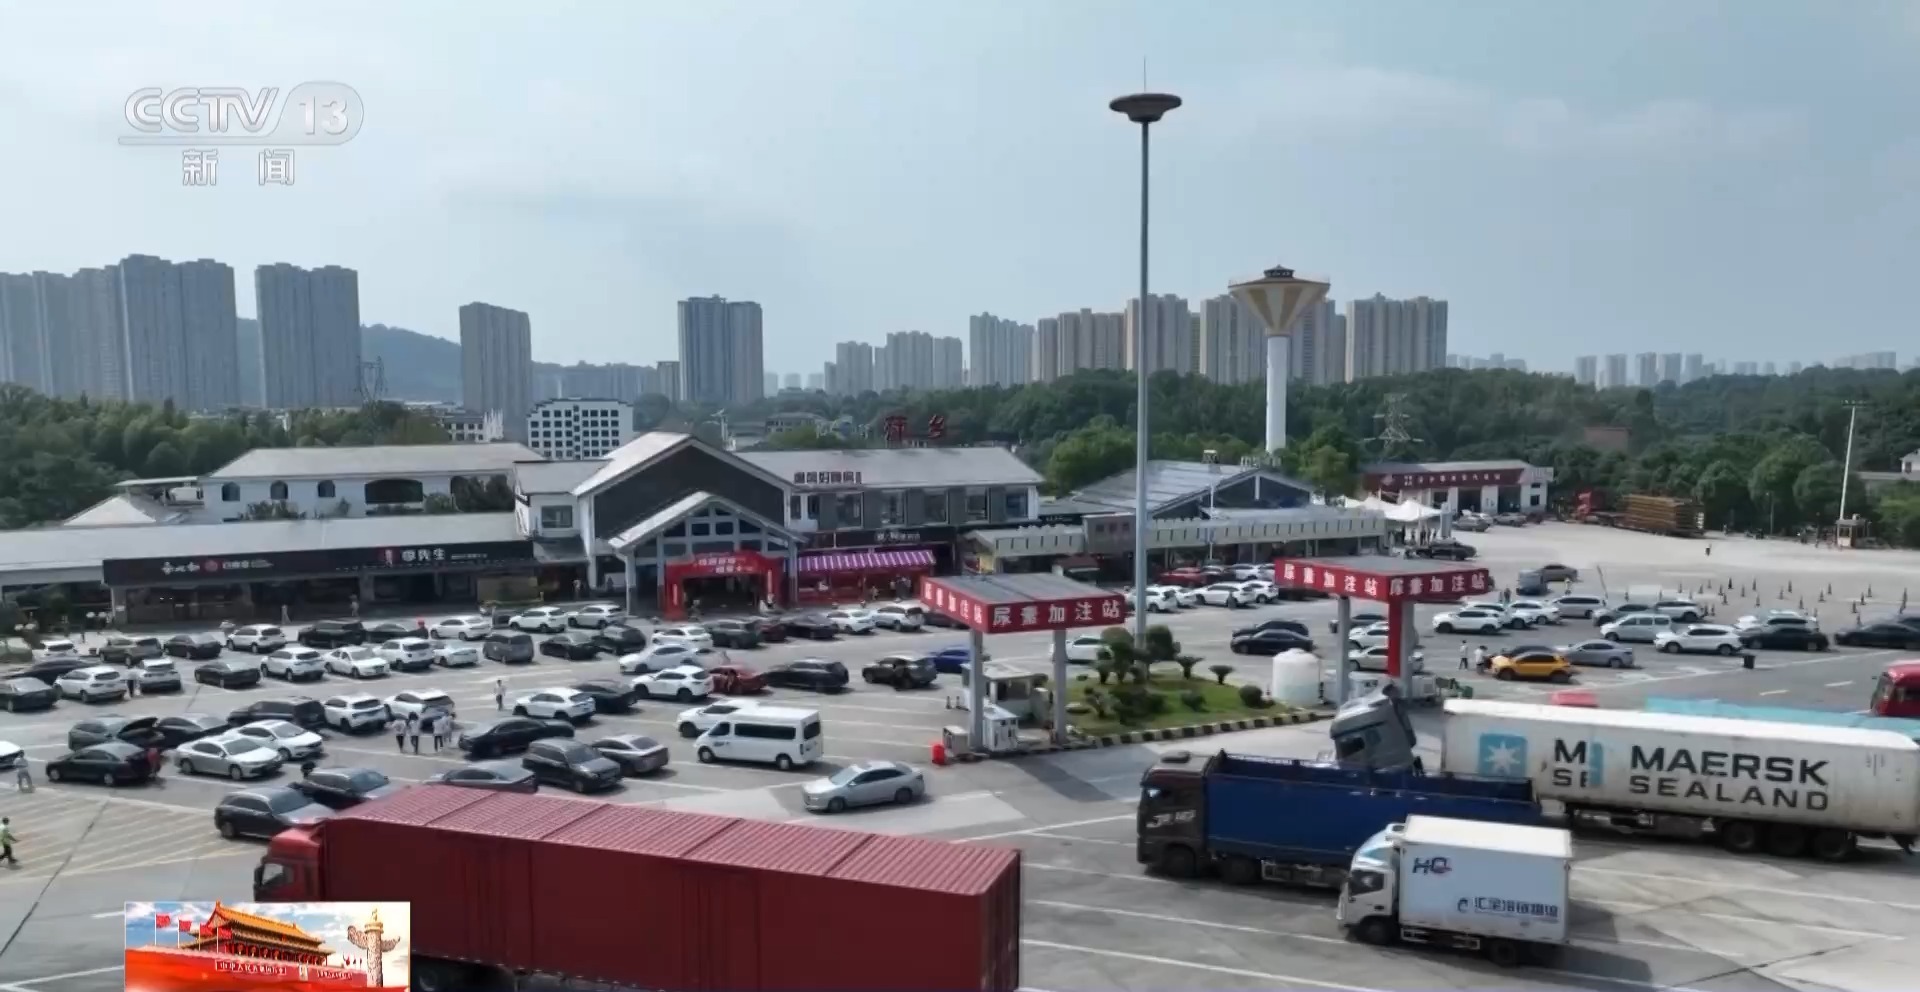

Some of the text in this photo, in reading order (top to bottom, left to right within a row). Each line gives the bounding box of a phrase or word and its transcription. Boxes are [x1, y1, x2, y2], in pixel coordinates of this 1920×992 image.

[1284, 563, 1379, 597] 尿素加注站
[1389, 570, 1486, 597] 尿素加注站
[992, 599, 1121, 628] 尿素加注站
[1630, 745, 1831, 787] MAERSK
[1629, 775, 1829, 812] SEALAND
